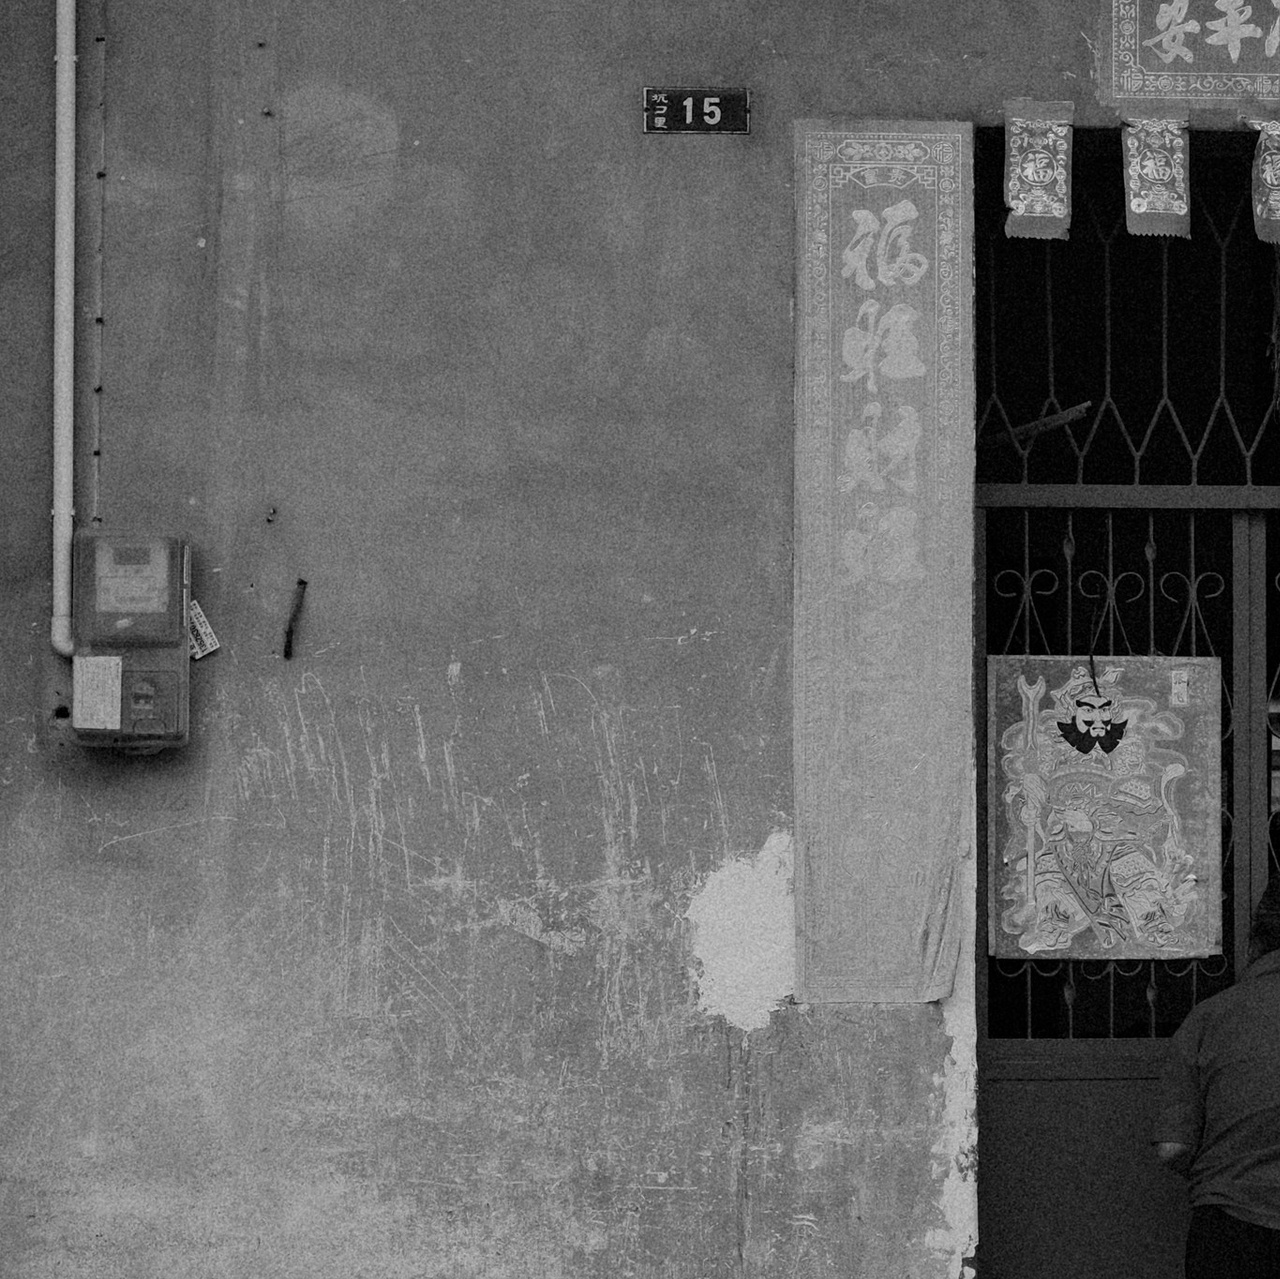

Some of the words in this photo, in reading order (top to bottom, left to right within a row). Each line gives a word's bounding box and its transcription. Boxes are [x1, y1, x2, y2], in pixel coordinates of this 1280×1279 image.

[682, 97, 722, 125] 15
[1021, 152, 1053, 182] 福
[1141, 152, 1170, 182] 福
